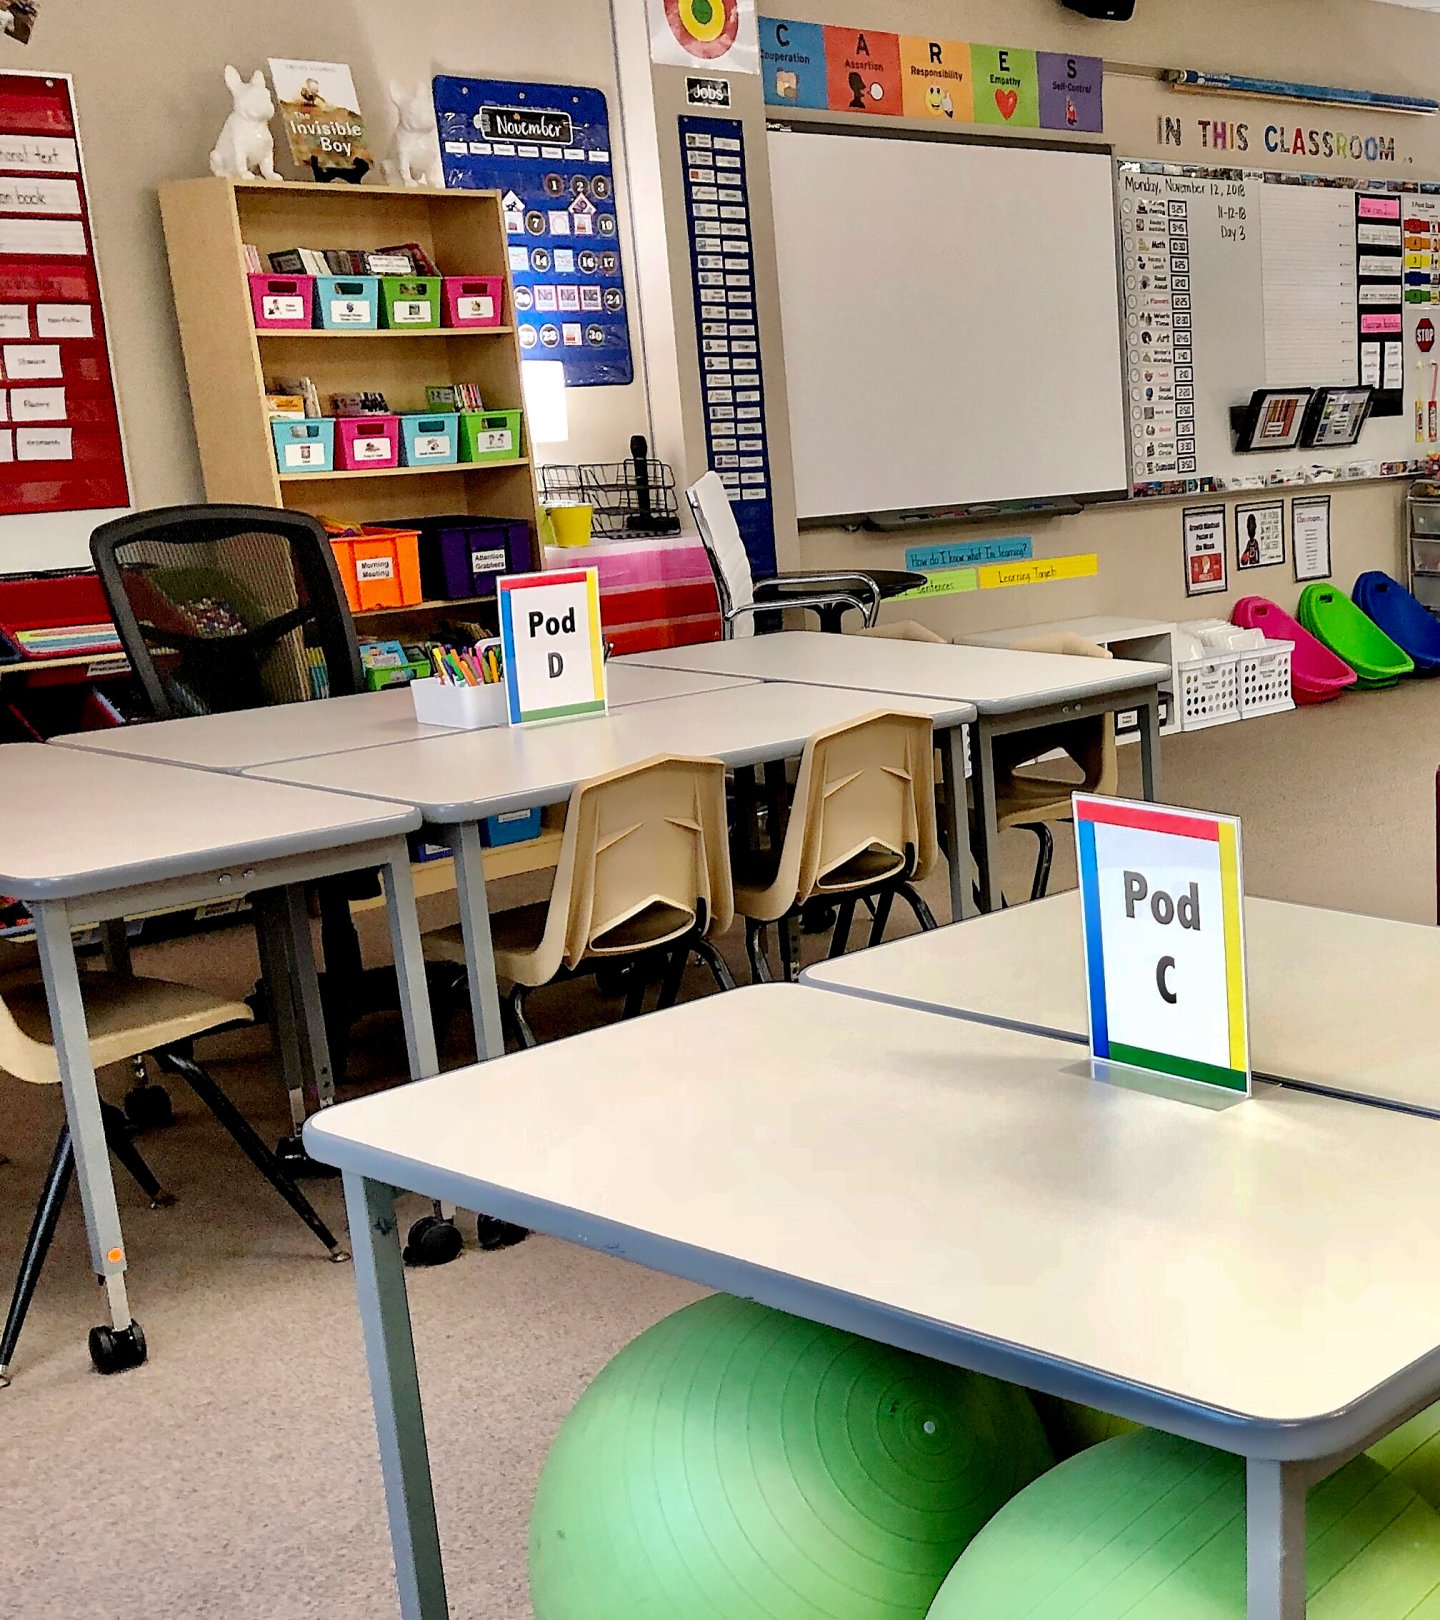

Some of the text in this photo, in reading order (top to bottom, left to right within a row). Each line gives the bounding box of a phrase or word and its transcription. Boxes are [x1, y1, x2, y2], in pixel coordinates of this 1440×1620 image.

[776, 24, 790, 47] C
[856, 33, 870, 56] A
[929, 43, 943, 64] R
[845, 59, 884, 72] Assertion
[999, 51, 1010, 72] E
[1066, 59, 1077, 79] S
[911, 65, 963, 82] Responsibility
[989, 74, 1021, 88] Empathy
[694, 86, 723, 100] Jobs
[1052, 82, 1092, 94] Self-Control
[290, 121, 361, 136] Invisible
[496, 115, 562, 137] November
[1157, 114, 1182, 146] IN
[1198, 120, 1249, 151] THIS
[320, 137, 351, 157] Boy
[551, 181, 604, 192] 1 2 3
[1125, 176, 1245, 197] Monday, November 12, 2018
[15, 186, 46, 206] book
[1218, 205, 1246, 220] 11-12-18
[532, 218, 612, 230] 7 10
[1220, 225, 1246, 241] Day 3
[1152, 241, 1166, 249] Math
[535, 255, 614, 268] 14 16 17
[607, 294, 620, 304] 24
[588, 330, 602, 341] 30
[1156, 334, 1170, 342] Art
[1417, 328, 1434, 342] STOP
[475, 552, 504, 562] Attention
[911, 554, 927, 567] How
[930, 555, 939, 565] do
[940, 552, 946, 563] I
[967, 547, 981, 561] what
[999, 543, 1027, 560] learning?
[362, 560, 389, 570] Morning
[475, 561, 505, 570] Grabbers
[998, 570, 1031, 584] Learning
[917, 582, 954, 594] sentences
[529, 607, 576, 638] Pod
[548, 652, 564, 678] D
[1123, 871, 1201, 931] Pod
[1156, 956, 1177, 1004] C
